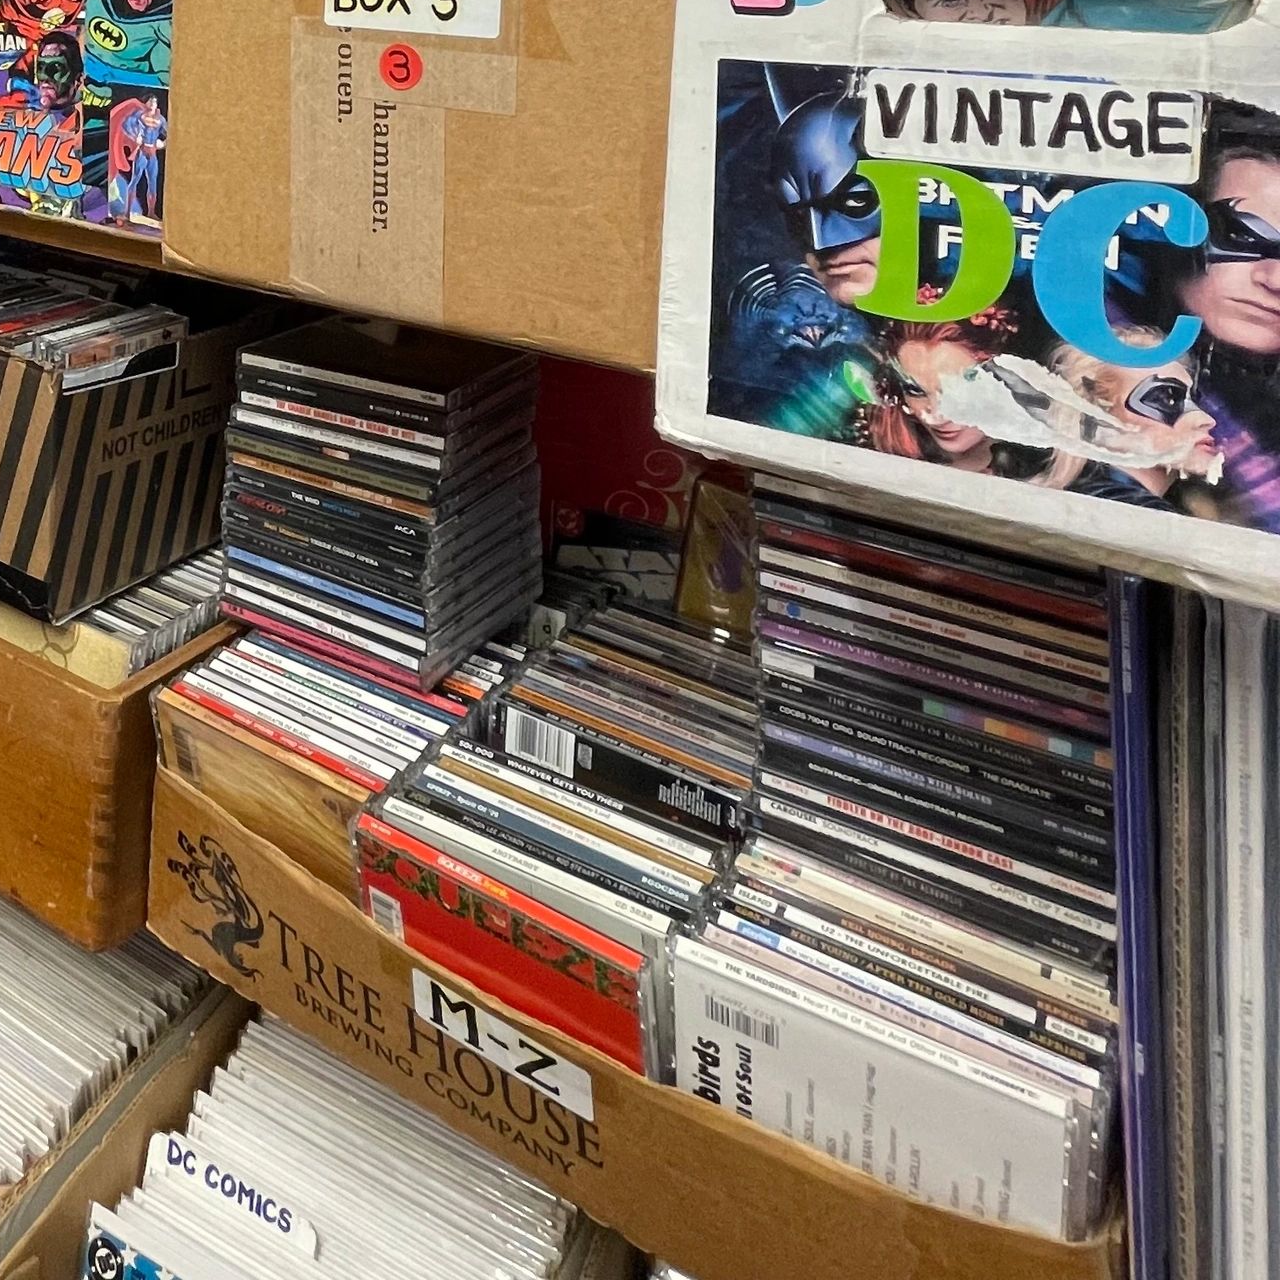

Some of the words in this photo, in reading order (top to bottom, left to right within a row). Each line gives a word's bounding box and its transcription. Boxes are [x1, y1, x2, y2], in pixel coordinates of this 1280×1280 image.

[874, 82, 1196, 157] VINTAGE
[854, 158, 1209, 369] DC
[102, 429, 138, 461] NOT
[507, 759, 553, 782] WHATEVER
[552, 773, 574, 793] GETS
[574, 782, 596, 800] YOU
[595, 790, 624, 811] THERE
[985, 847, 1014, 870] CAST
[737, 888, 773, 909] ISLAND
[268, 909, 385, 1033] TREE
[724, 961, 742, 976] THE
[820, 923, 836, 938] U2
[844, 932, 865, 948] THE
[865, 940, 963, 987] UNFORGETTABLE
[965, 982, 990, 1001] FIRE
[428, 980, 561, 1096] M-Z
[691, 1034, 721, 1105] birds
[735, 1043, 753, 1084] Soul
[295, 983, 414, 1079] BREWING
[424, 1069, 575, 1177] COMPANY
[166, 1137, 198, 1175] DC
[203, 1161, 293, 1234] COMICS
